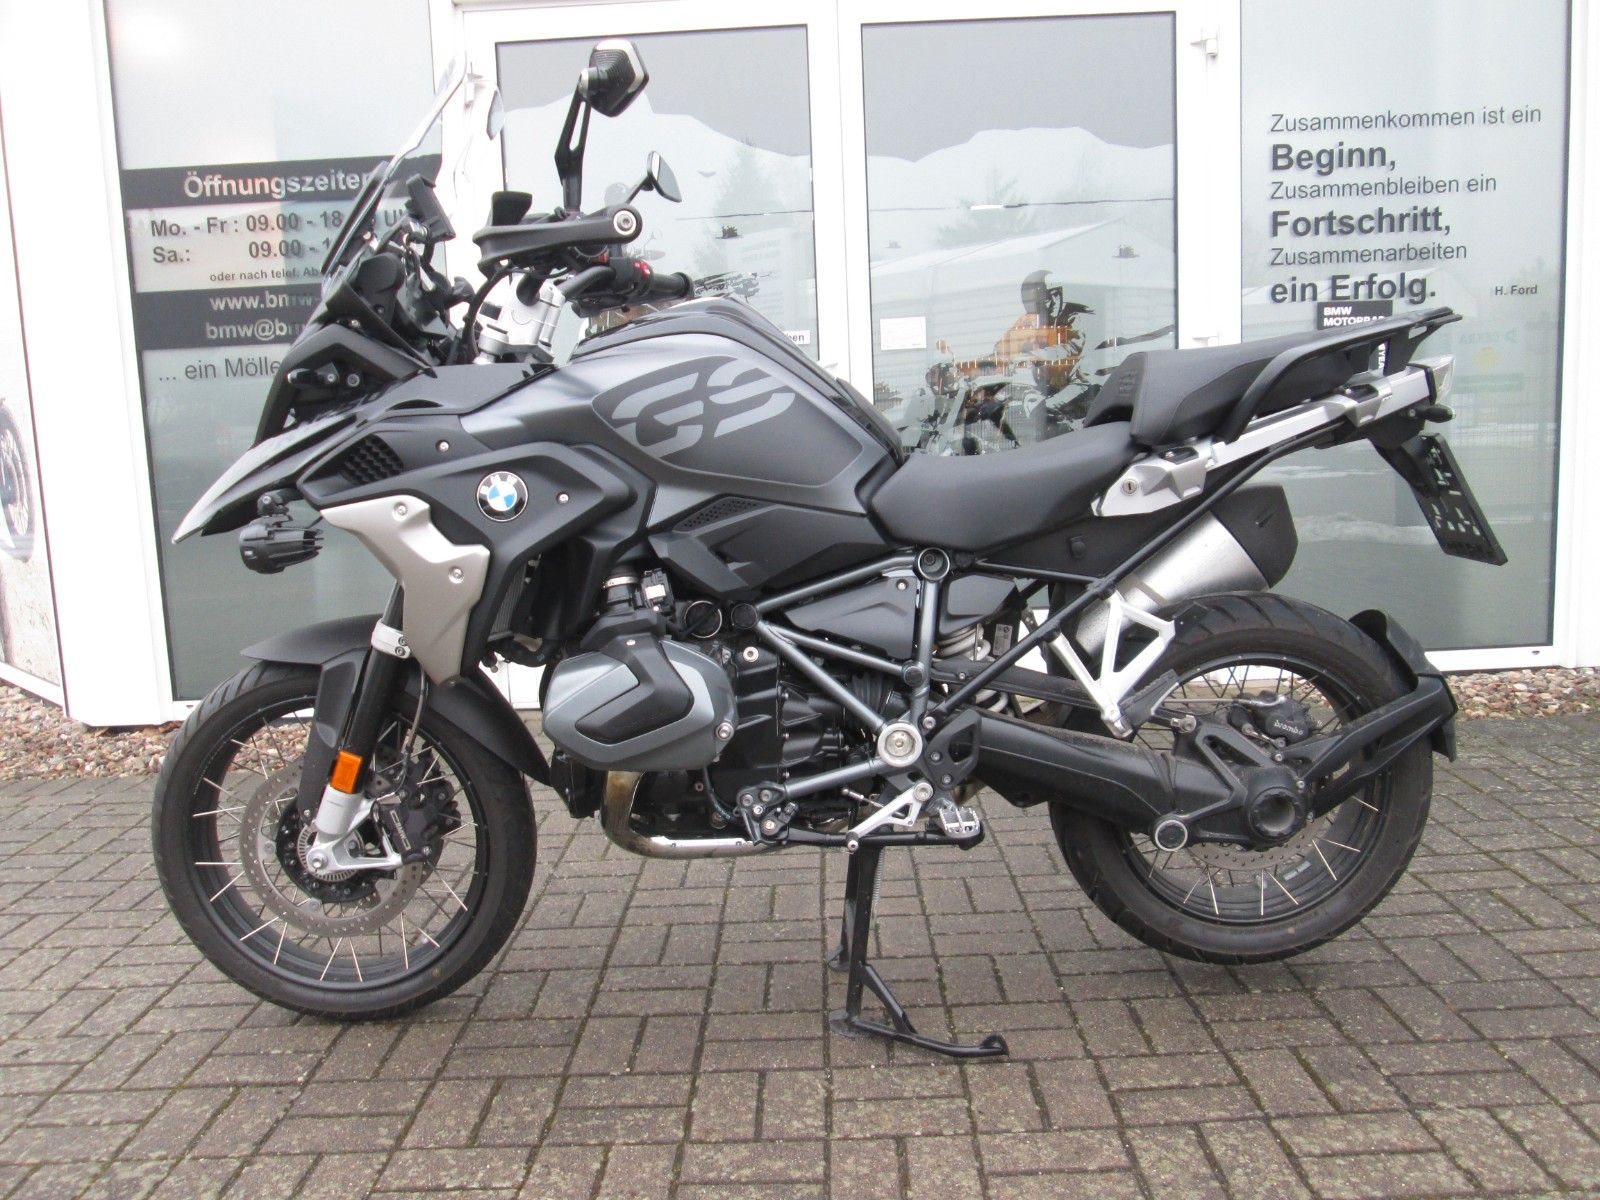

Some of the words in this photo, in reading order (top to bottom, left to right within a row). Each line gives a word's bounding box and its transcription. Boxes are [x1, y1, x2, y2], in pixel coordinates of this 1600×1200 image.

[1270, 110, 1475, 132] Zusammenkommen
[1483, 107, 1505, 124] ist
[1512, 105, 1542, 124] ein
[1271, 141, 1396, 177] Beginn,
[1270, 176, 1459, 200] Zusammenbleiben
[1466, 174, 1497, 192] ein
[151, 219, 187, 237] Mo.
[246, 213, 300, 232] 09.00
[1271, 206, 1451, 237] Fortschritt,
[153, 246, 190, 263] Sa.:
[248, 239, 302, 259] 09.00
[1270, 243, 1467, 266] Zusammenarbeiten
[210, 272, 236, 282] oder
[240, 270, 267, 280] nach
[1270, 276, 1318, 304] ein
[1331, 273, 1436, 305] Erfolg.
[1494, 286, 1507, 296] H.
[1511, 285, 1538, 296] Ford
[1323, 306, 1352, 316] BMW
[184, 360, 217, 380] ein
[1273, 719, 1304, 736] brembo
